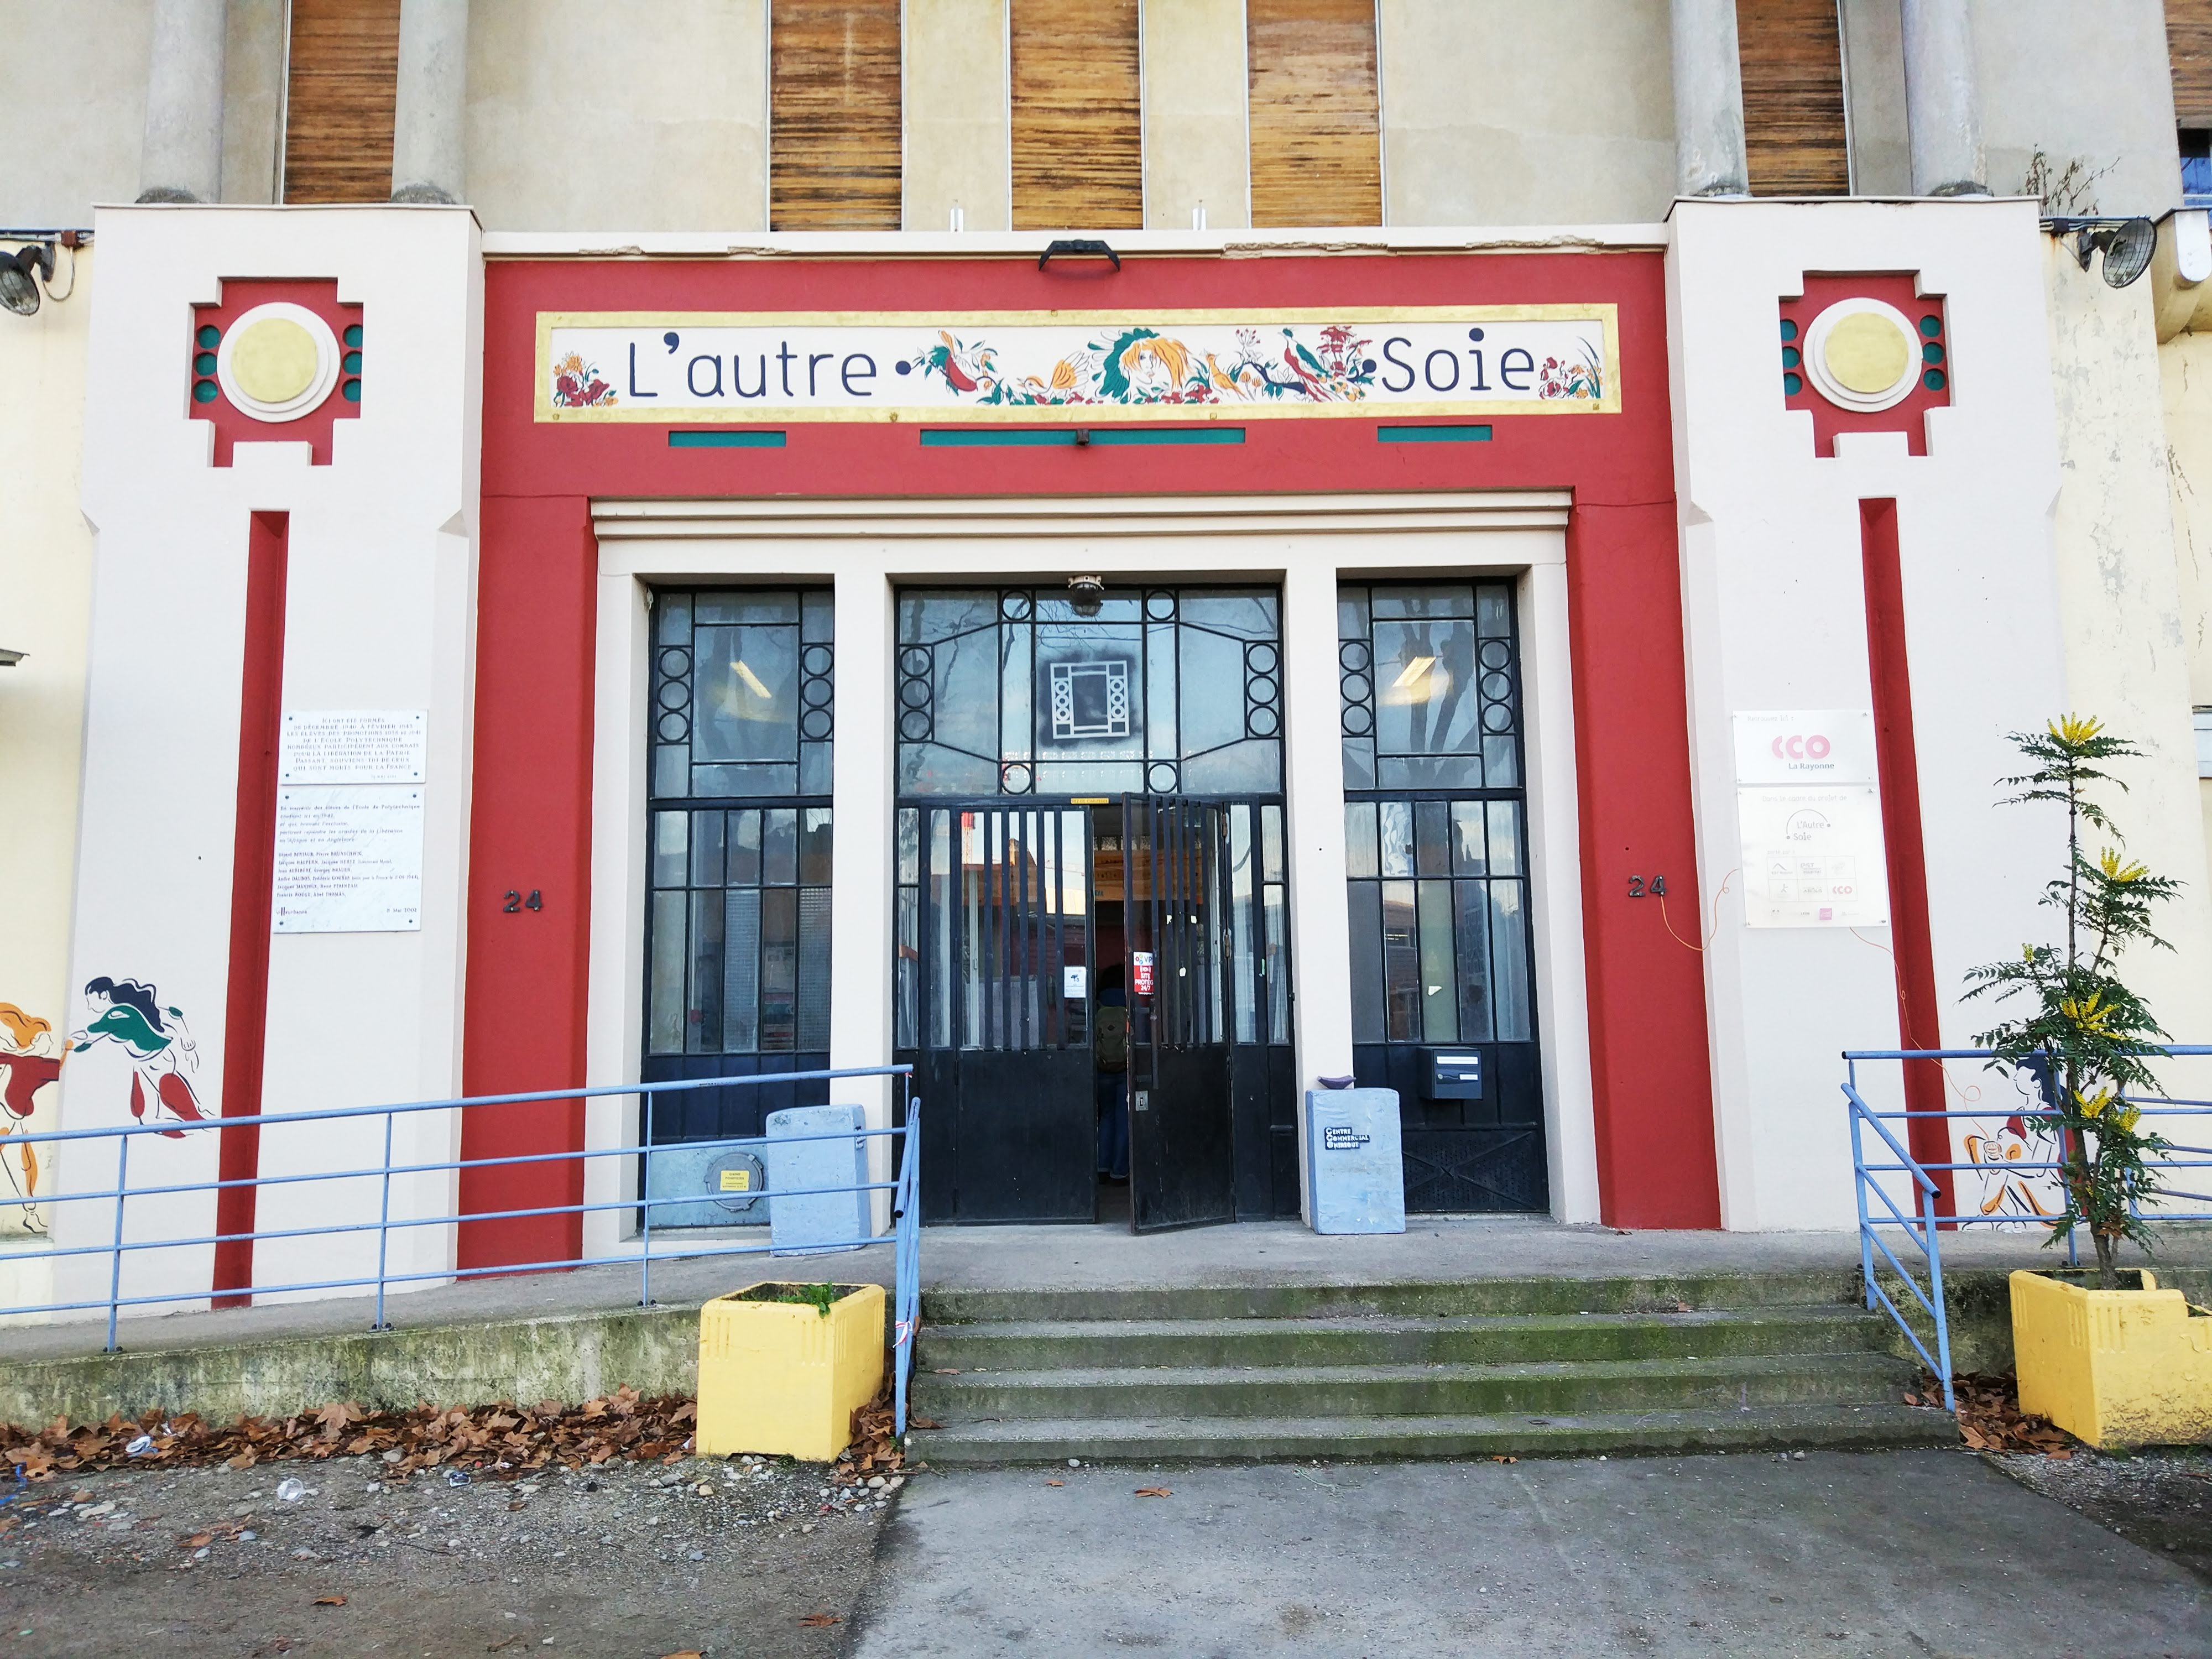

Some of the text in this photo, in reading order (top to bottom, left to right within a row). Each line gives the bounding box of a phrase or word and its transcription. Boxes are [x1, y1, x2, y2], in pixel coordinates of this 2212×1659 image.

[629, 328, 1535, 398] L'autre Soie
[1772, 734, 1830, 759] CCO
[1800, 763, 1834, 771] Rayonne
[1797, 821, 1824, 829] L'Autre
[1793, 832, 1812, 841] Soie
[1628, 875, 1667, 897] 24
[503, 890, 542, 912] 24
